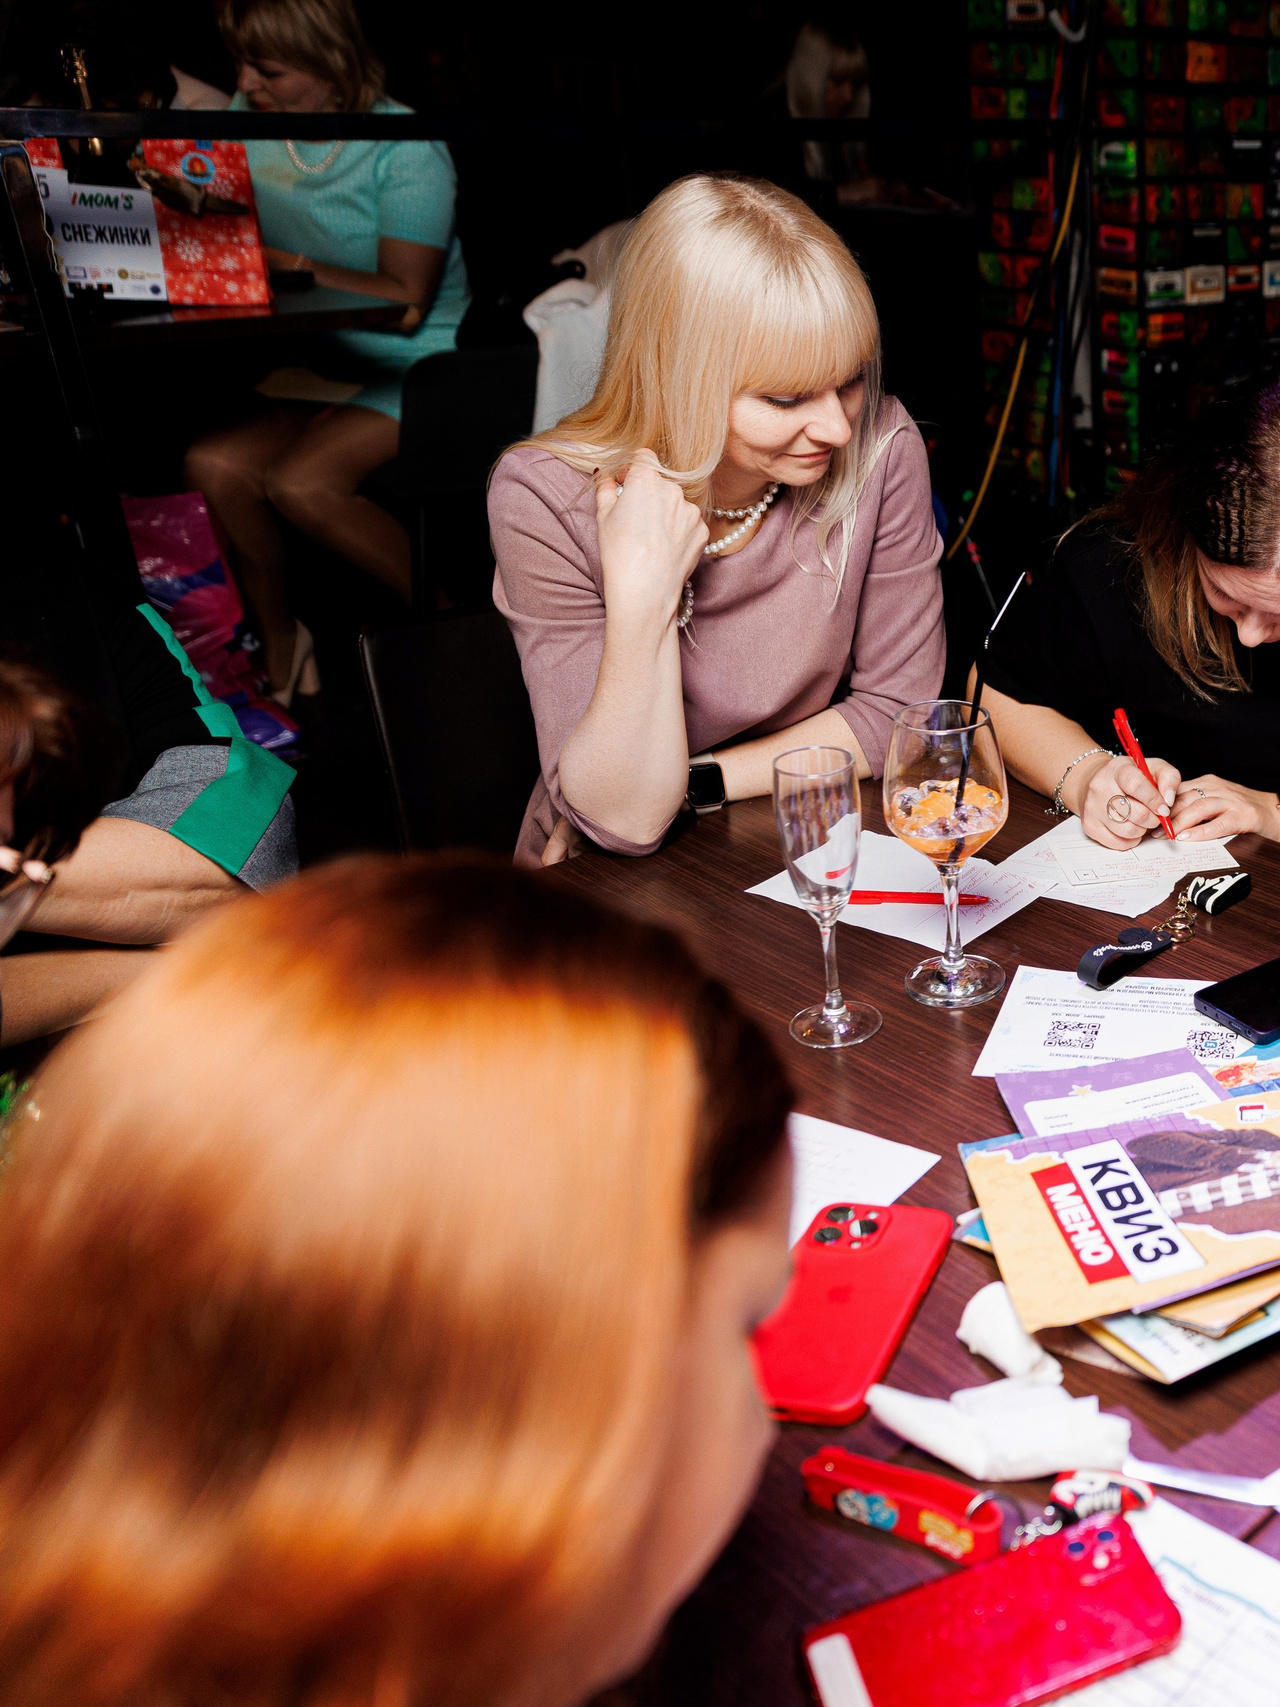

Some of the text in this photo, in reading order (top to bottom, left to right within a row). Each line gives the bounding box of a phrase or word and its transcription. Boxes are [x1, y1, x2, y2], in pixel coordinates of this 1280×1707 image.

[61, 222, 152, 246] СНЕЖИНКИ
[1045, 1182, 1114, 1267] МЕНЮ
[1081, 1156, 1181, 1267] КВИЗ
